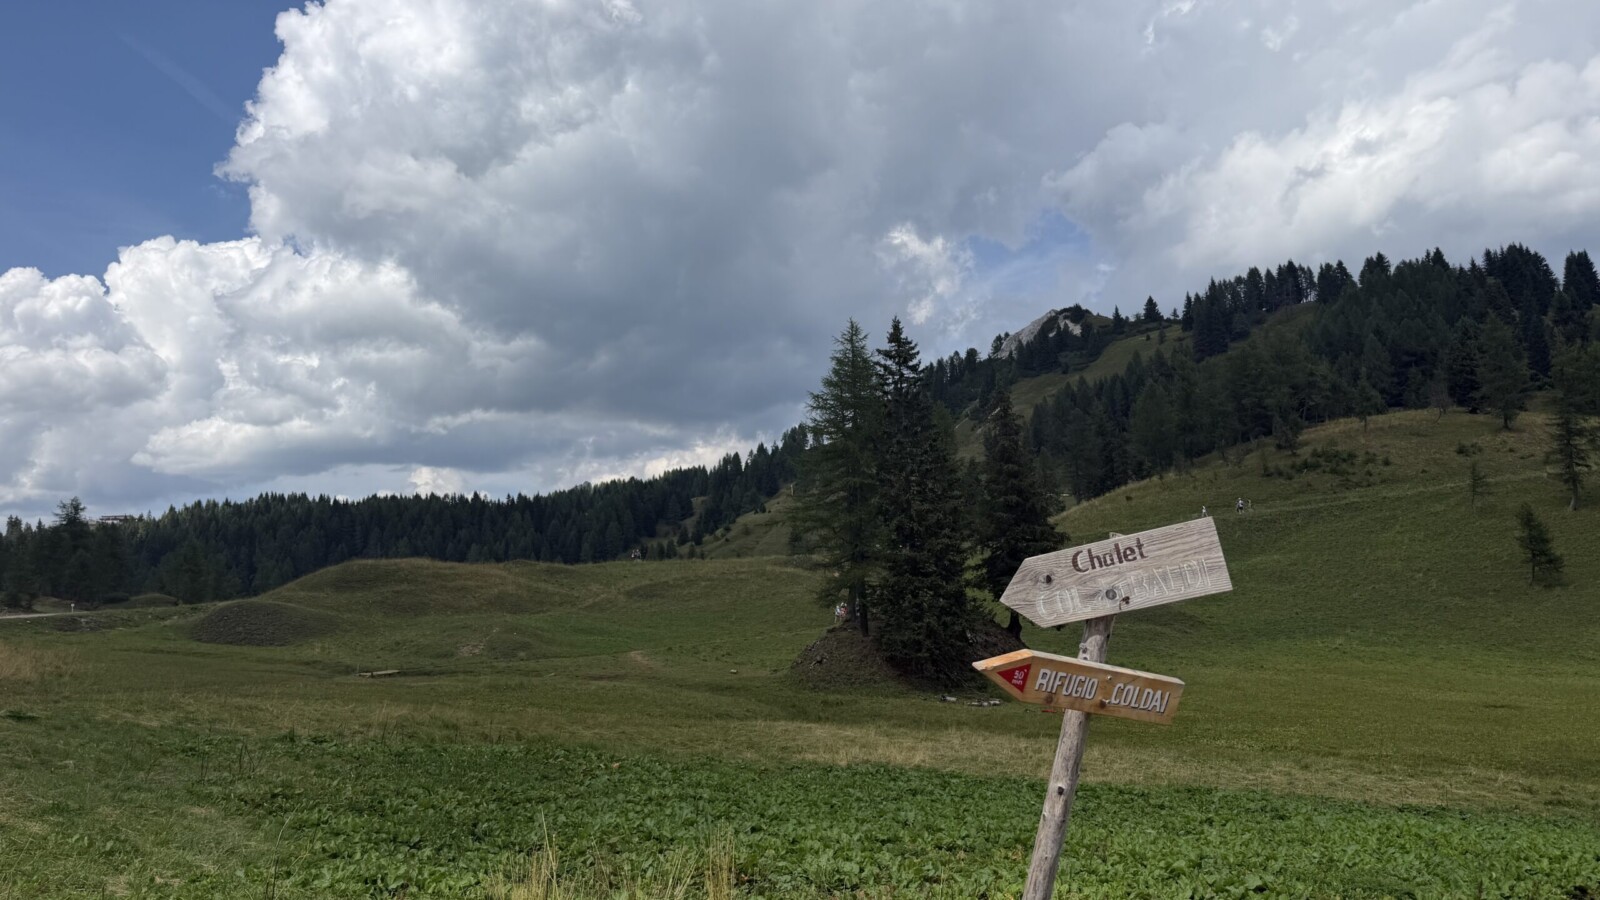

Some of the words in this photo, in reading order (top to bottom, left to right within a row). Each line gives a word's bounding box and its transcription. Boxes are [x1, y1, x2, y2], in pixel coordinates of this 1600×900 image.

[1071, 537, 1148, 573] Chalet
[1034, 668, 1099, 700] RIFUGIO
[1110, 682, 1171, 714] COLDAI
